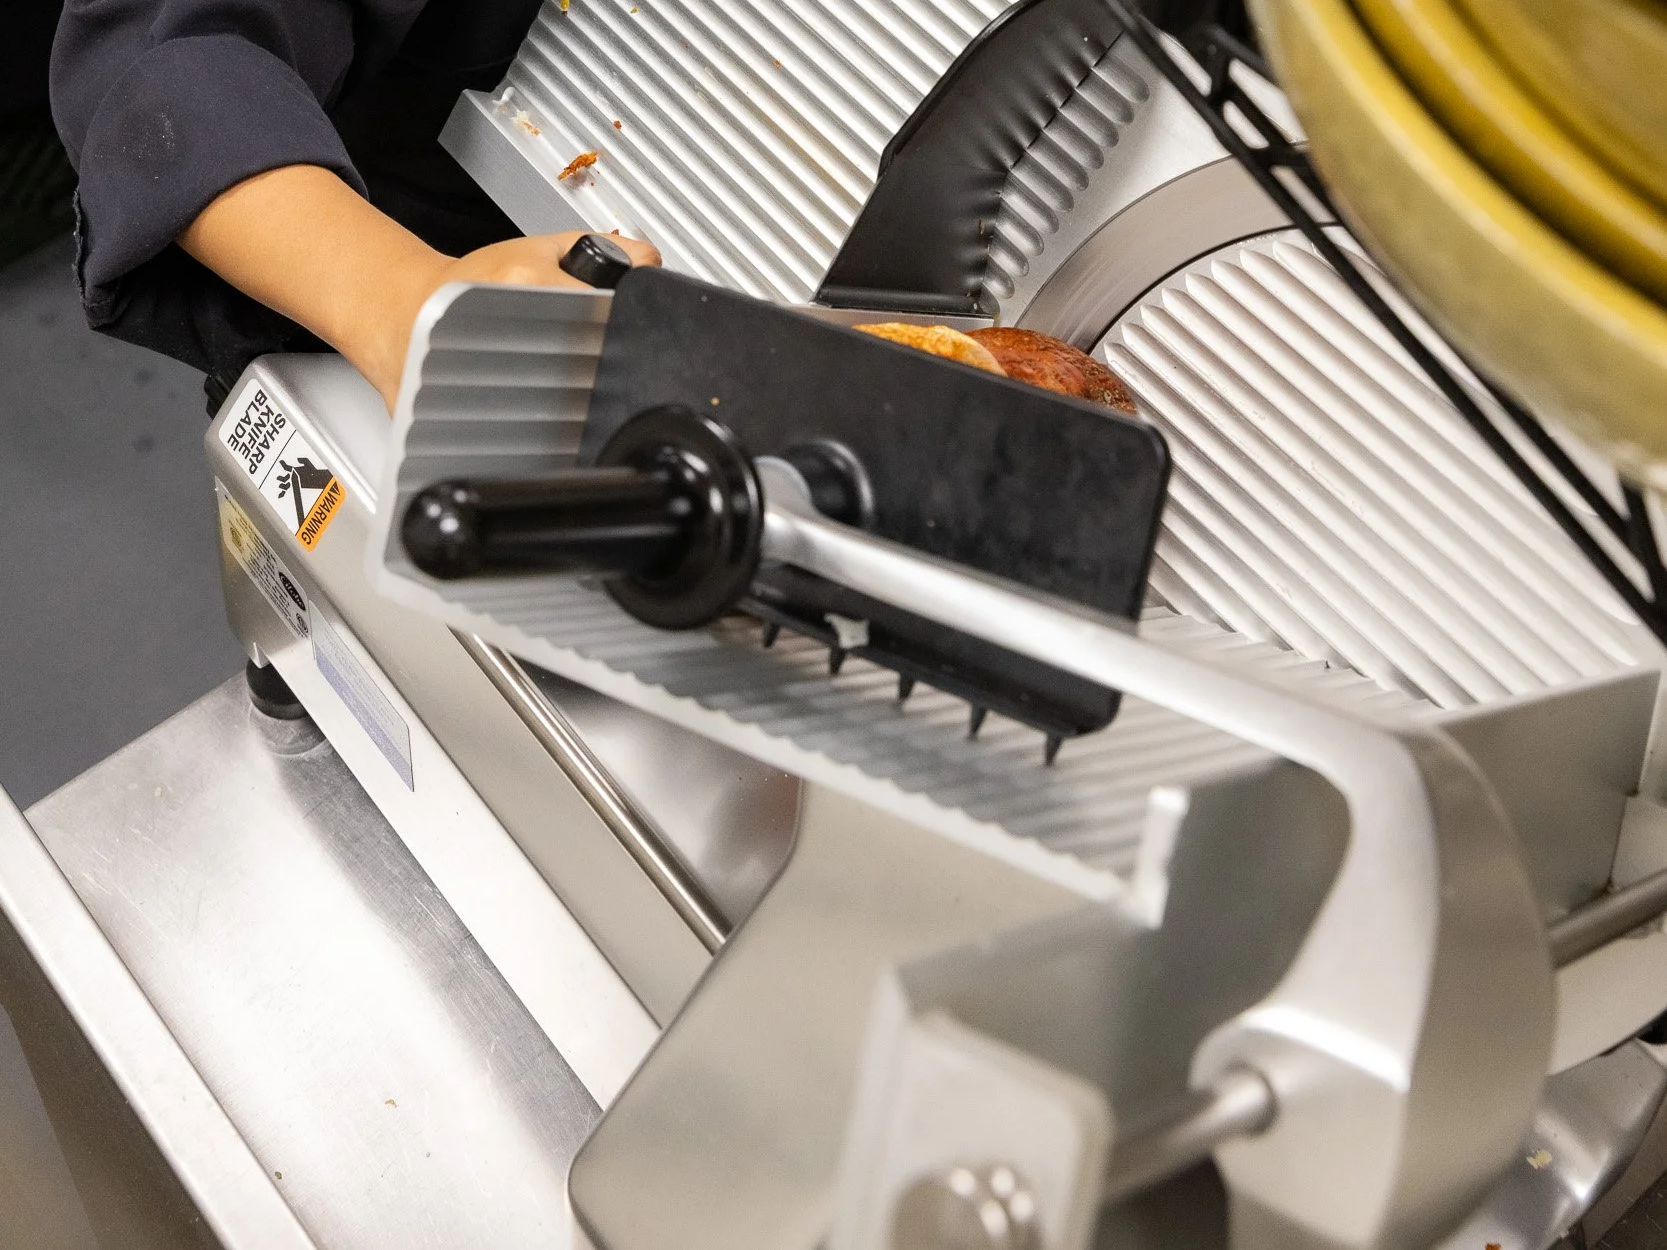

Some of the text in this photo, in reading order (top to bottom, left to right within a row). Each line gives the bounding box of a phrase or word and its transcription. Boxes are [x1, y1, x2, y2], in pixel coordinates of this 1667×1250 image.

[227, 388, 268, 452] BLADE
[238, 404, 275, 460] KNIFE
[248, 413, 286, 475] SHARP
[301, 492, 338, 546] WARNING
